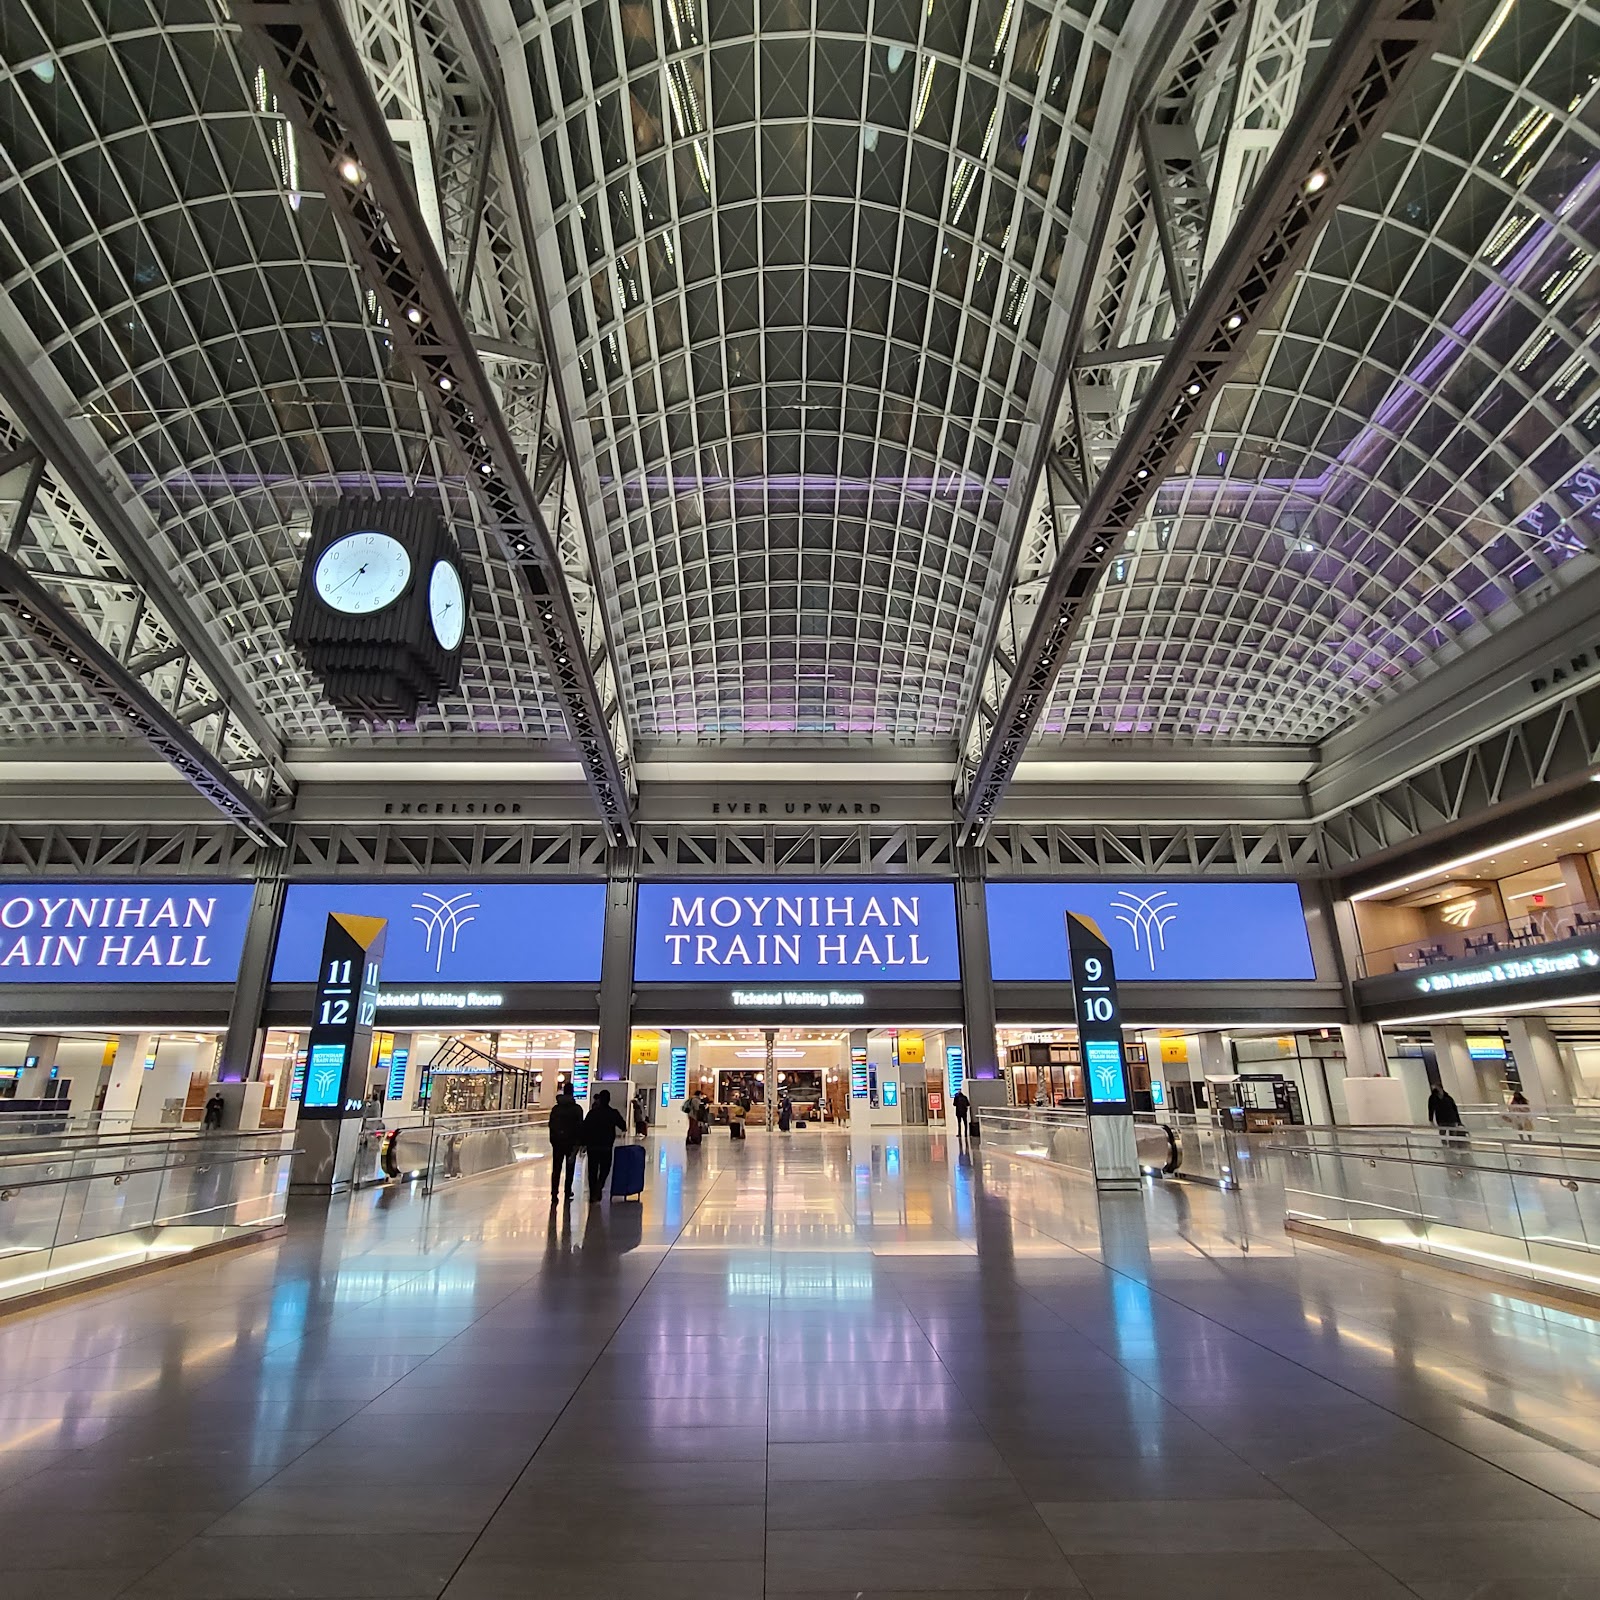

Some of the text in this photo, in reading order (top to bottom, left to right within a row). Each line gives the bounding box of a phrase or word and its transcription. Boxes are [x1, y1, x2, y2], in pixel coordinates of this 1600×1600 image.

[347, 541, 355, 549] 11
[365, 537, 375, 545] 12
[387, 541, 391, 549] 1
[331, 552, 340, 560] 10
[396, 553, 402, 561] 2
[323, 568, 329, 576] 9
[398, 569, 404, 577] 3
[324, 584, 331, 592] 8
[390, 585, 396, 593] 4
[336, 596, 342, 605] 7
[354, 602, 360, 610] 6
[373, 597, 380, 605] 5
[384, 802, 522, 815] EXCELSIOR
[712, 802, 881, 815] EVER UPWARD
[0, 897, 217, 929] OYNIHAN
[668, 896, 920, 927] MOYNIHAN
[96, 935, 212, 966] HALL
[664, 934, 930, 966] TRAIN HALL
[327, 959, 352, 984] 11
[366, 962, 379, 987] 11
[1084, 957, 1103, 982] 9
[1452, 969, 1494, 988] Avenue
[1506, 962, 1536, 979] 31st
[1535, 953, 1581, 974] Street
[376, 992, 502, 1008] icketed Waiting Room
[731, 991, 865, 1007] Ticketed Waiting Room
[319, 999, 350, 1025] 12
[359, 1001, 375, 1027] 12
[1083, 997, 1113, 1021] 10
